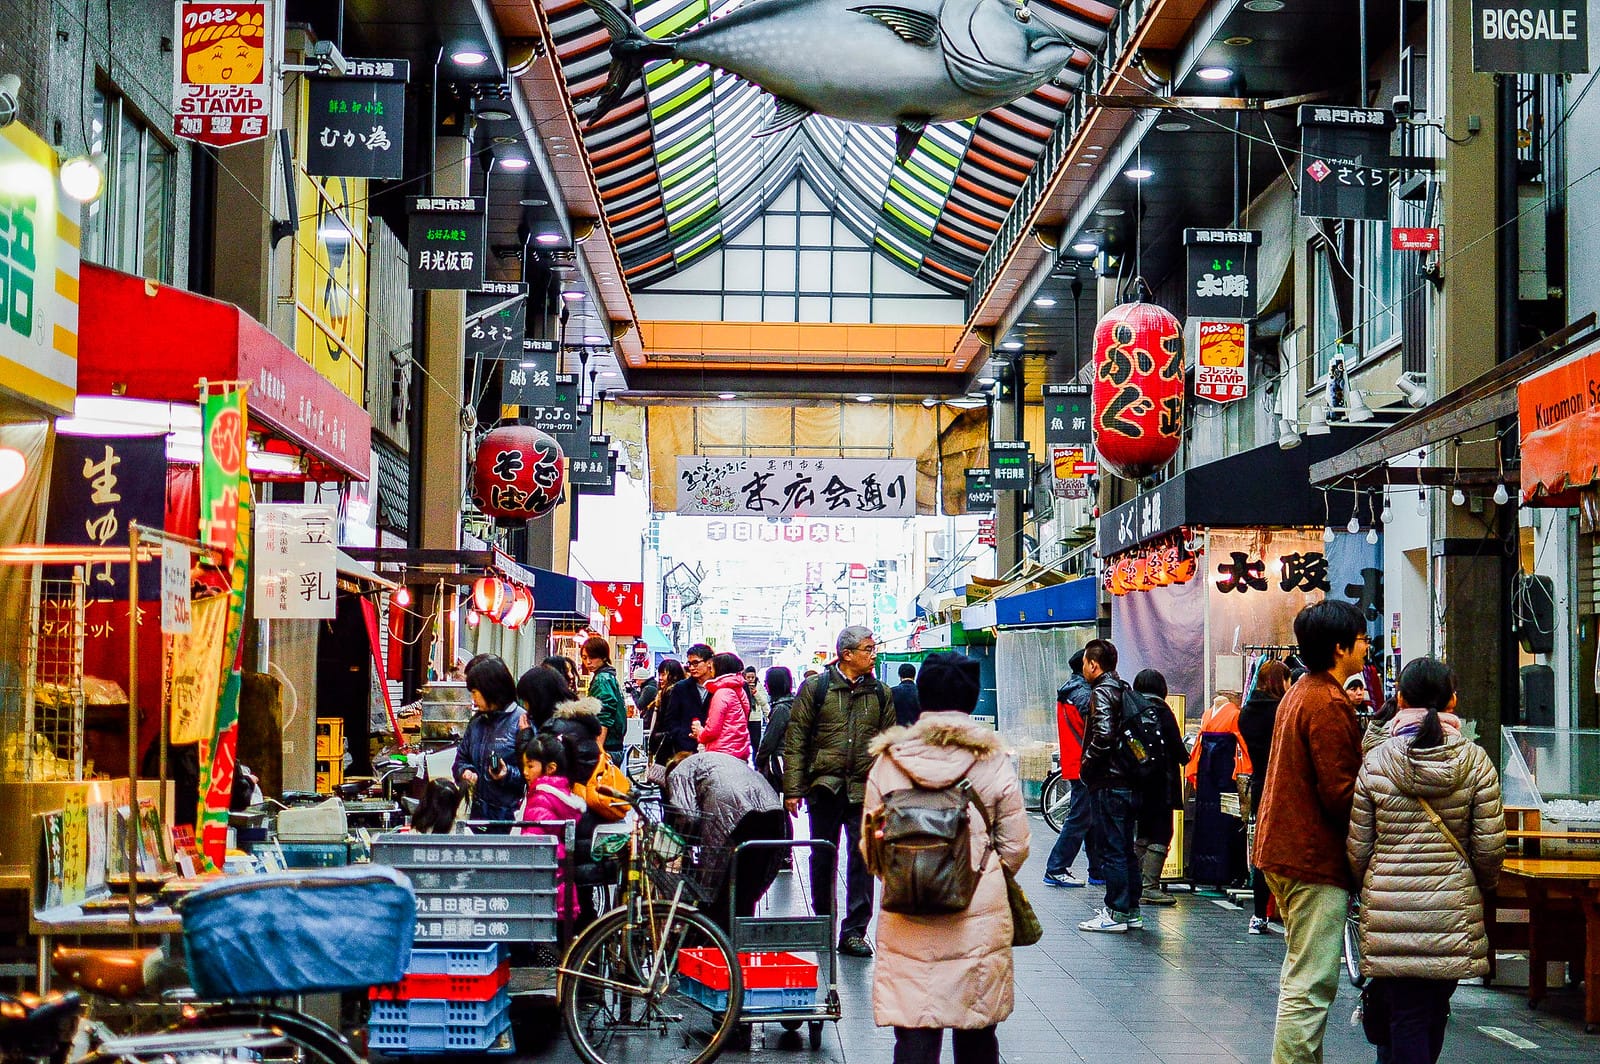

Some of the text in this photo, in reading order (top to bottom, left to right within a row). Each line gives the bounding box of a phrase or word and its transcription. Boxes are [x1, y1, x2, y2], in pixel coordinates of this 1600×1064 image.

[184, 8, 237, 28] クロモン
[1482, 9, 1577, 40] BIGSALE
[188, 84, 254, 98] フレッシュ
[180, 98, 263, 114] STAMP
[1314, 108, 1385, 125] 黒門市場
[180, 116, 263, 135] 加盟店
[1337, 166, 1384, 186] さくら
[416, 198, 476, 211] 黒門市場
[1196, 230, 1253, 243] 黒門市場
[417, 249, 474, 272] 月光仮面
[471, 282, 520, 294] 門市場
[471, 325, 514, 340] あそこ
[1200, 323, 1231, 335] クロモン
[1203, 366, 1239, 375] フレッシュ
[1099, 322, 1155, 438] ふぐ
[1199, 374, 1244, 384] STAMP
[1535, 391, 1584, 430] Kuromon
[300, 515, 332, 602] 豆乳
[615, 593, 643, 607] すし
